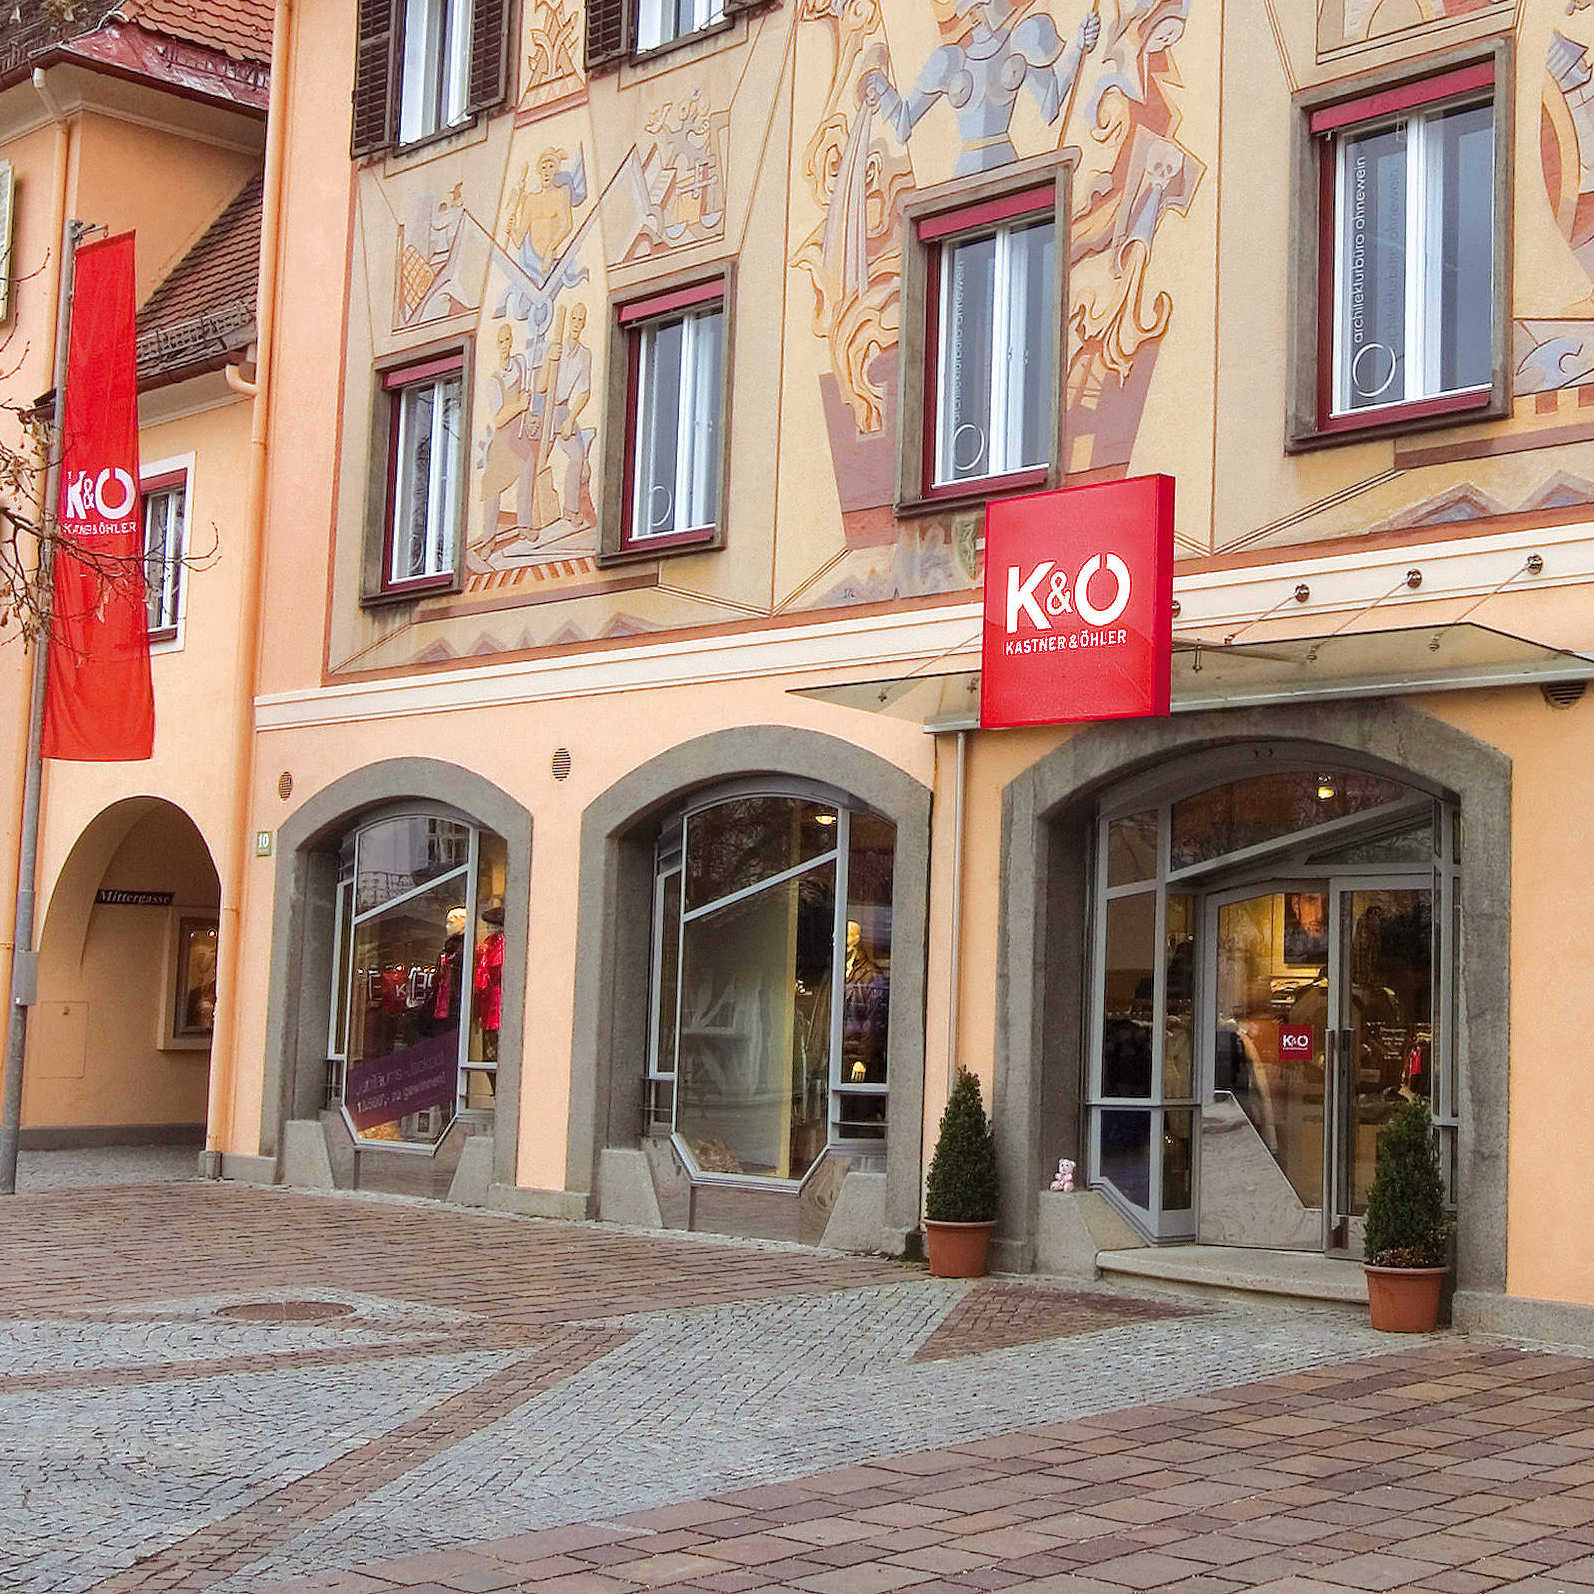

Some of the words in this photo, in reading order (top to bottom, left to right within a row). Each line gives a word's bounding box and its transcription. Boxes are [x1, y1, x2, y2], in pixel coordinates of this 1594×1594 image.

[1351, 156, 1366, 230] ohnewein
[1005, 635, 1066, 656] KASTNER
[1080, 628, 1127, 648] ÖHLER
[257, 833, 269, 847] 10
